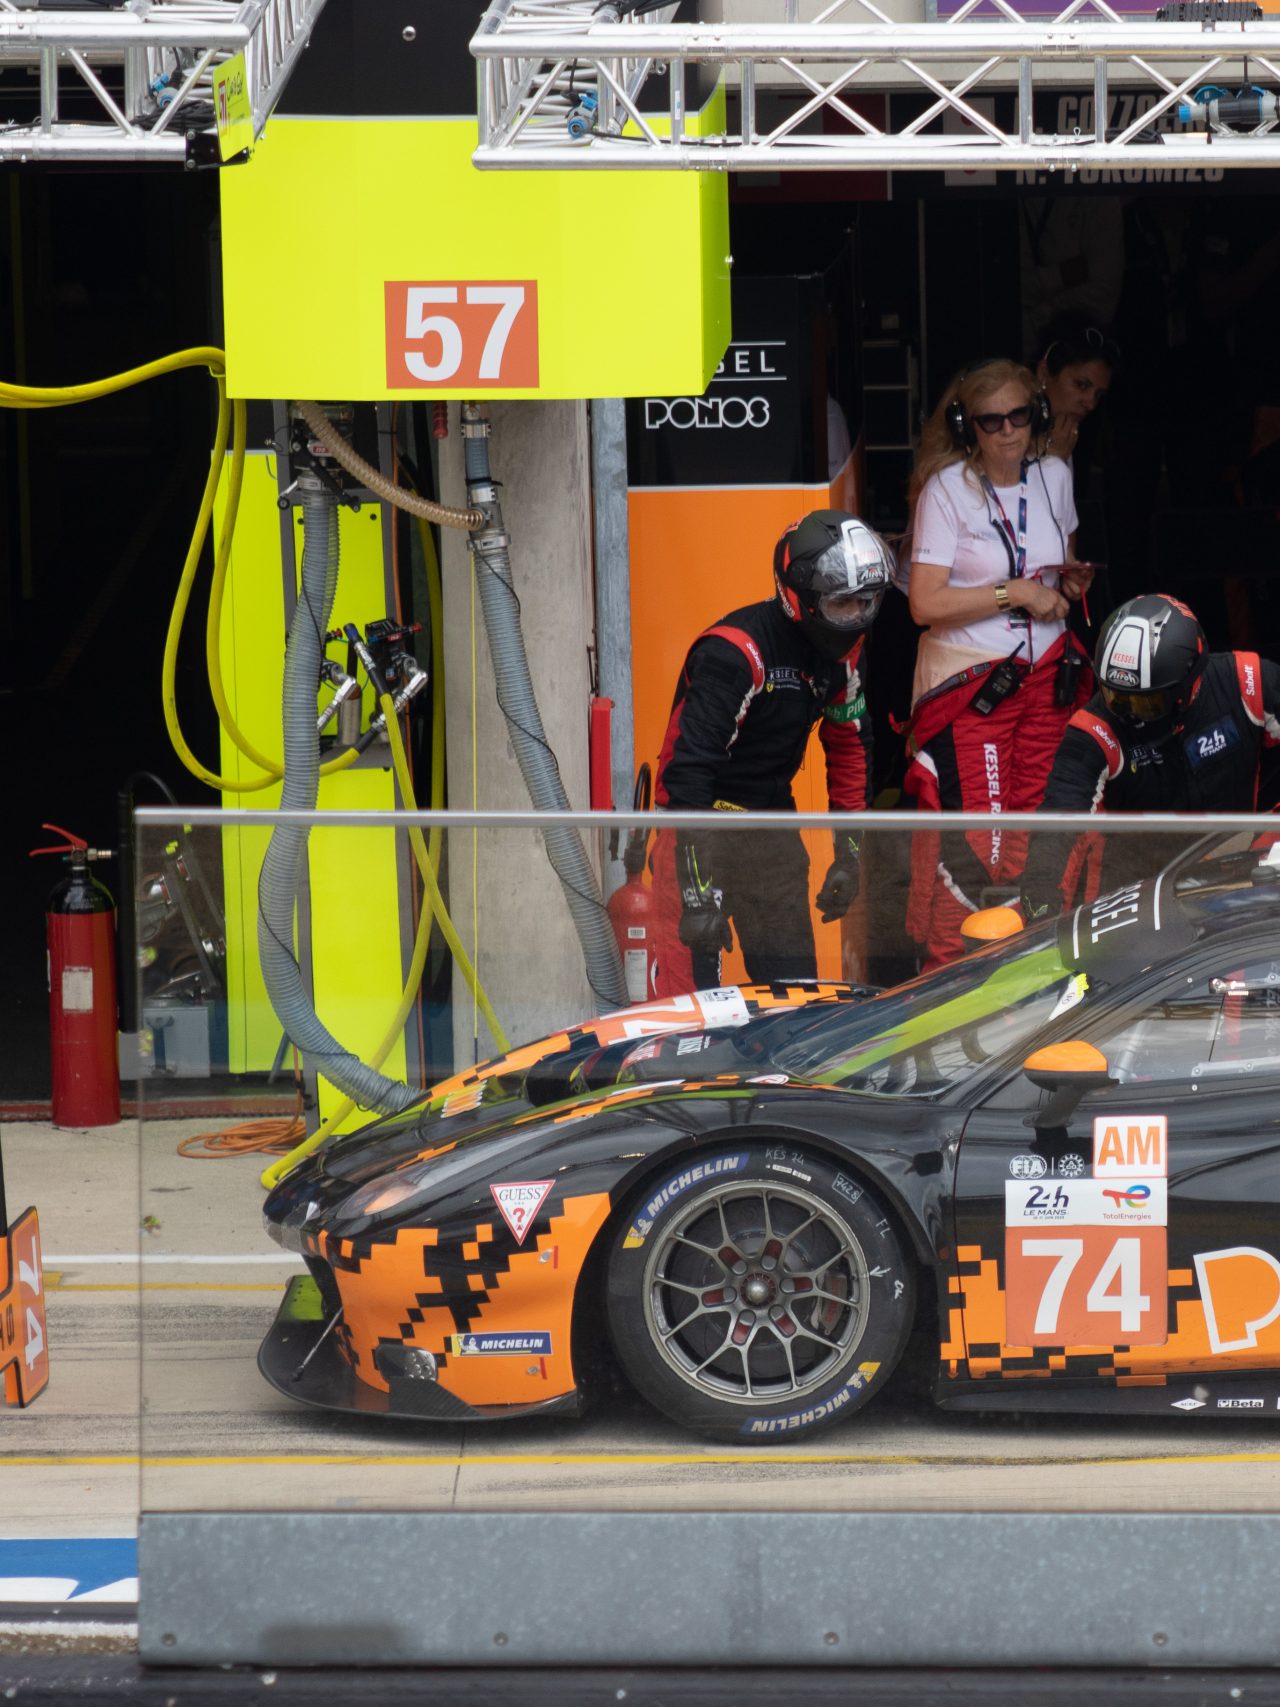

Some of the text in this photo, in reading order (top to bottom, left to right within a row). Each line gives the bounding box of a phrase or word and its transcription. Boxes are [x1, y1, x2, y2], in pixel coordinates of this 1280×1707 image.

[404, 286, 524, 381] 57
[644, 396, 770, 429] PONOS
[1114, 652, 1136, 665] KESSEL
[983, 743, 1002, 864] KESSEL RCING
[1098, 1126, 1161, 1166] AM
[499, 1187, 541, 1202] GUESS
[648, 1157, 739, 1217] MICHELIN
[1025, 1185, 1069, 1208] 24h
[1102, 1212, 1152, 1221] TotalEnergies
[18, 1236, 44, 1371] 74
[1022, 1237, 1150, 1334] 74
[481, 1337, 543, 1351] MICHELIN
[751, 1389, 850, 1432] MICHELIN
[1231, 1400, 1262, 1408] Beta
